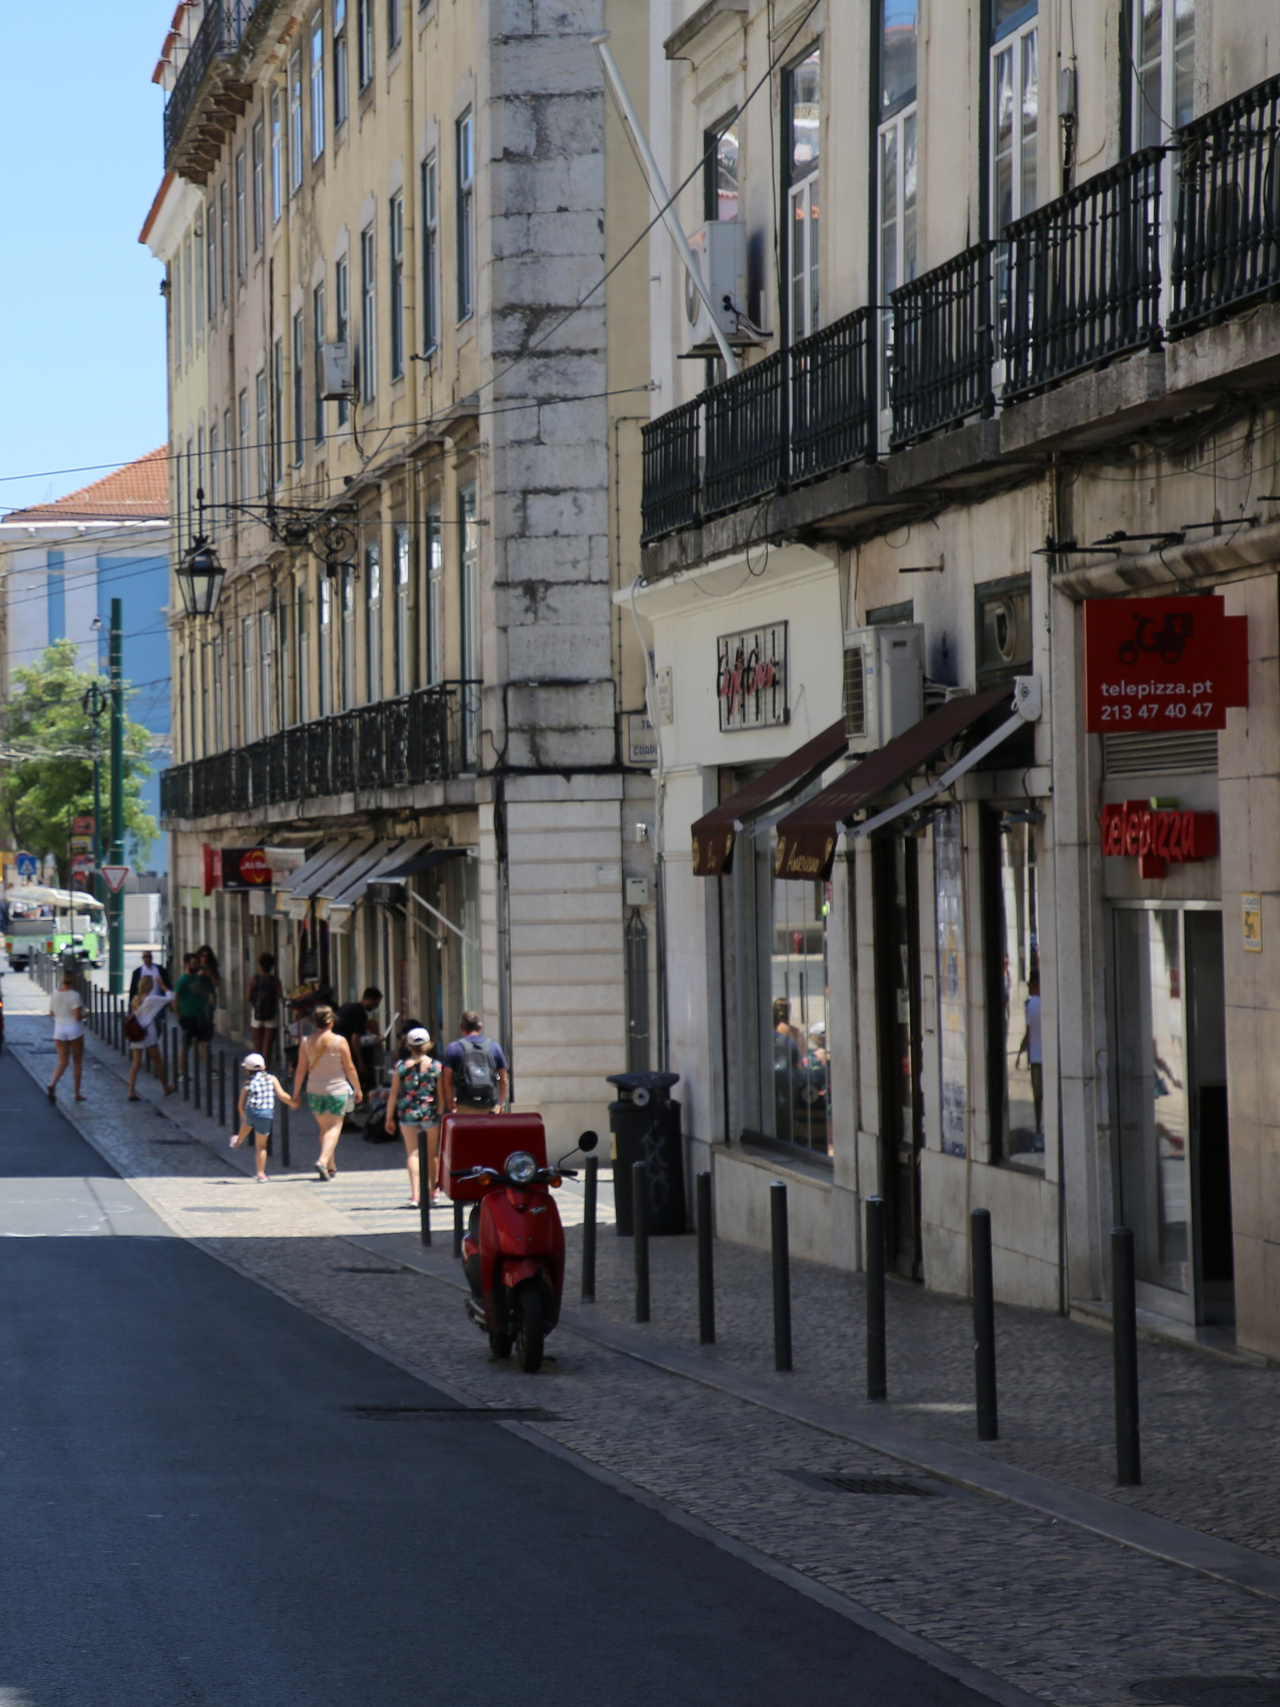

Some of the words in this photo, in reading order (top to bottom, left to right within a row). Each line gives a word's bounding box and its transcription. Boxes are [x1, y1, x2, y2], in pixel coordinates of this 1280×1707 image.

[1101, 680, 1213, 699] telepizza.pt
[1101, 705, 1132, 720] 213
[1138, 704, 1159, 719] 47
[1165, 704, 1187, 718] 40
[1192, 702, 1213, 717] 47
[1100, 797, 1198, 878] telepizza
